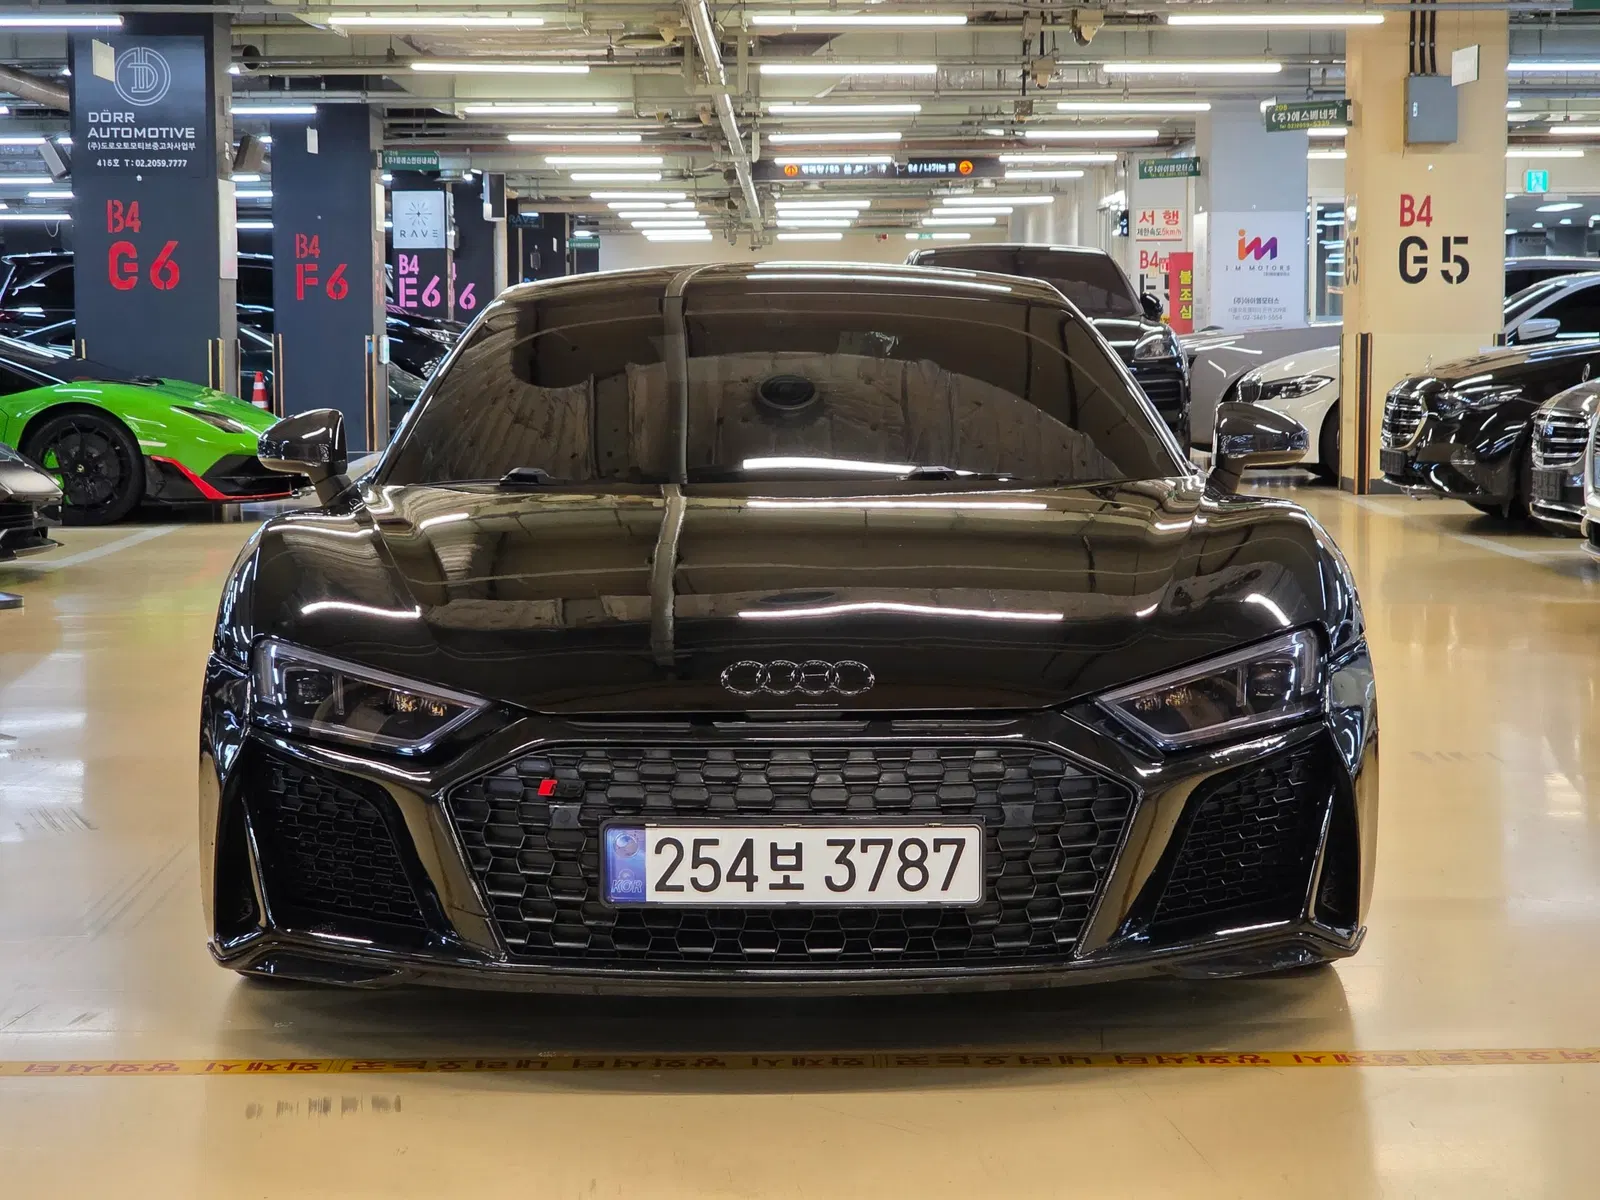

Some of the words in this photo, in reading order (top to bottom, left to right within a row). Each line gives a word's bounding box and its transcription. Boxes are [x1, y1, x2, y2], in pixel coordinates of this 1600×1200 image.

[88, 109, 135, 123] DÖRR
[87, 127, 195, 139] AUTOMOTIVE
[106, 199, 141, 233] B4
[1399, 194, 1433, 227] B4
[295, 233, 321, 259] B4
[400, 229, 438, 238] RAVE
[108, 240, 180, 290] G6
[398, 254, 419, 275] B4
[1140, 250, 1159, 269] B4
[1398, 236, 1470, 285] G5
[296, 263, 349, 301] F6
[398, 275, 441, 308] E6
[454, 283, 476, 310] 6
[654, 836, 805, 893] 254보
[824, 837, 966, 893] 3787
[610, 878, 643, 894] KOR
